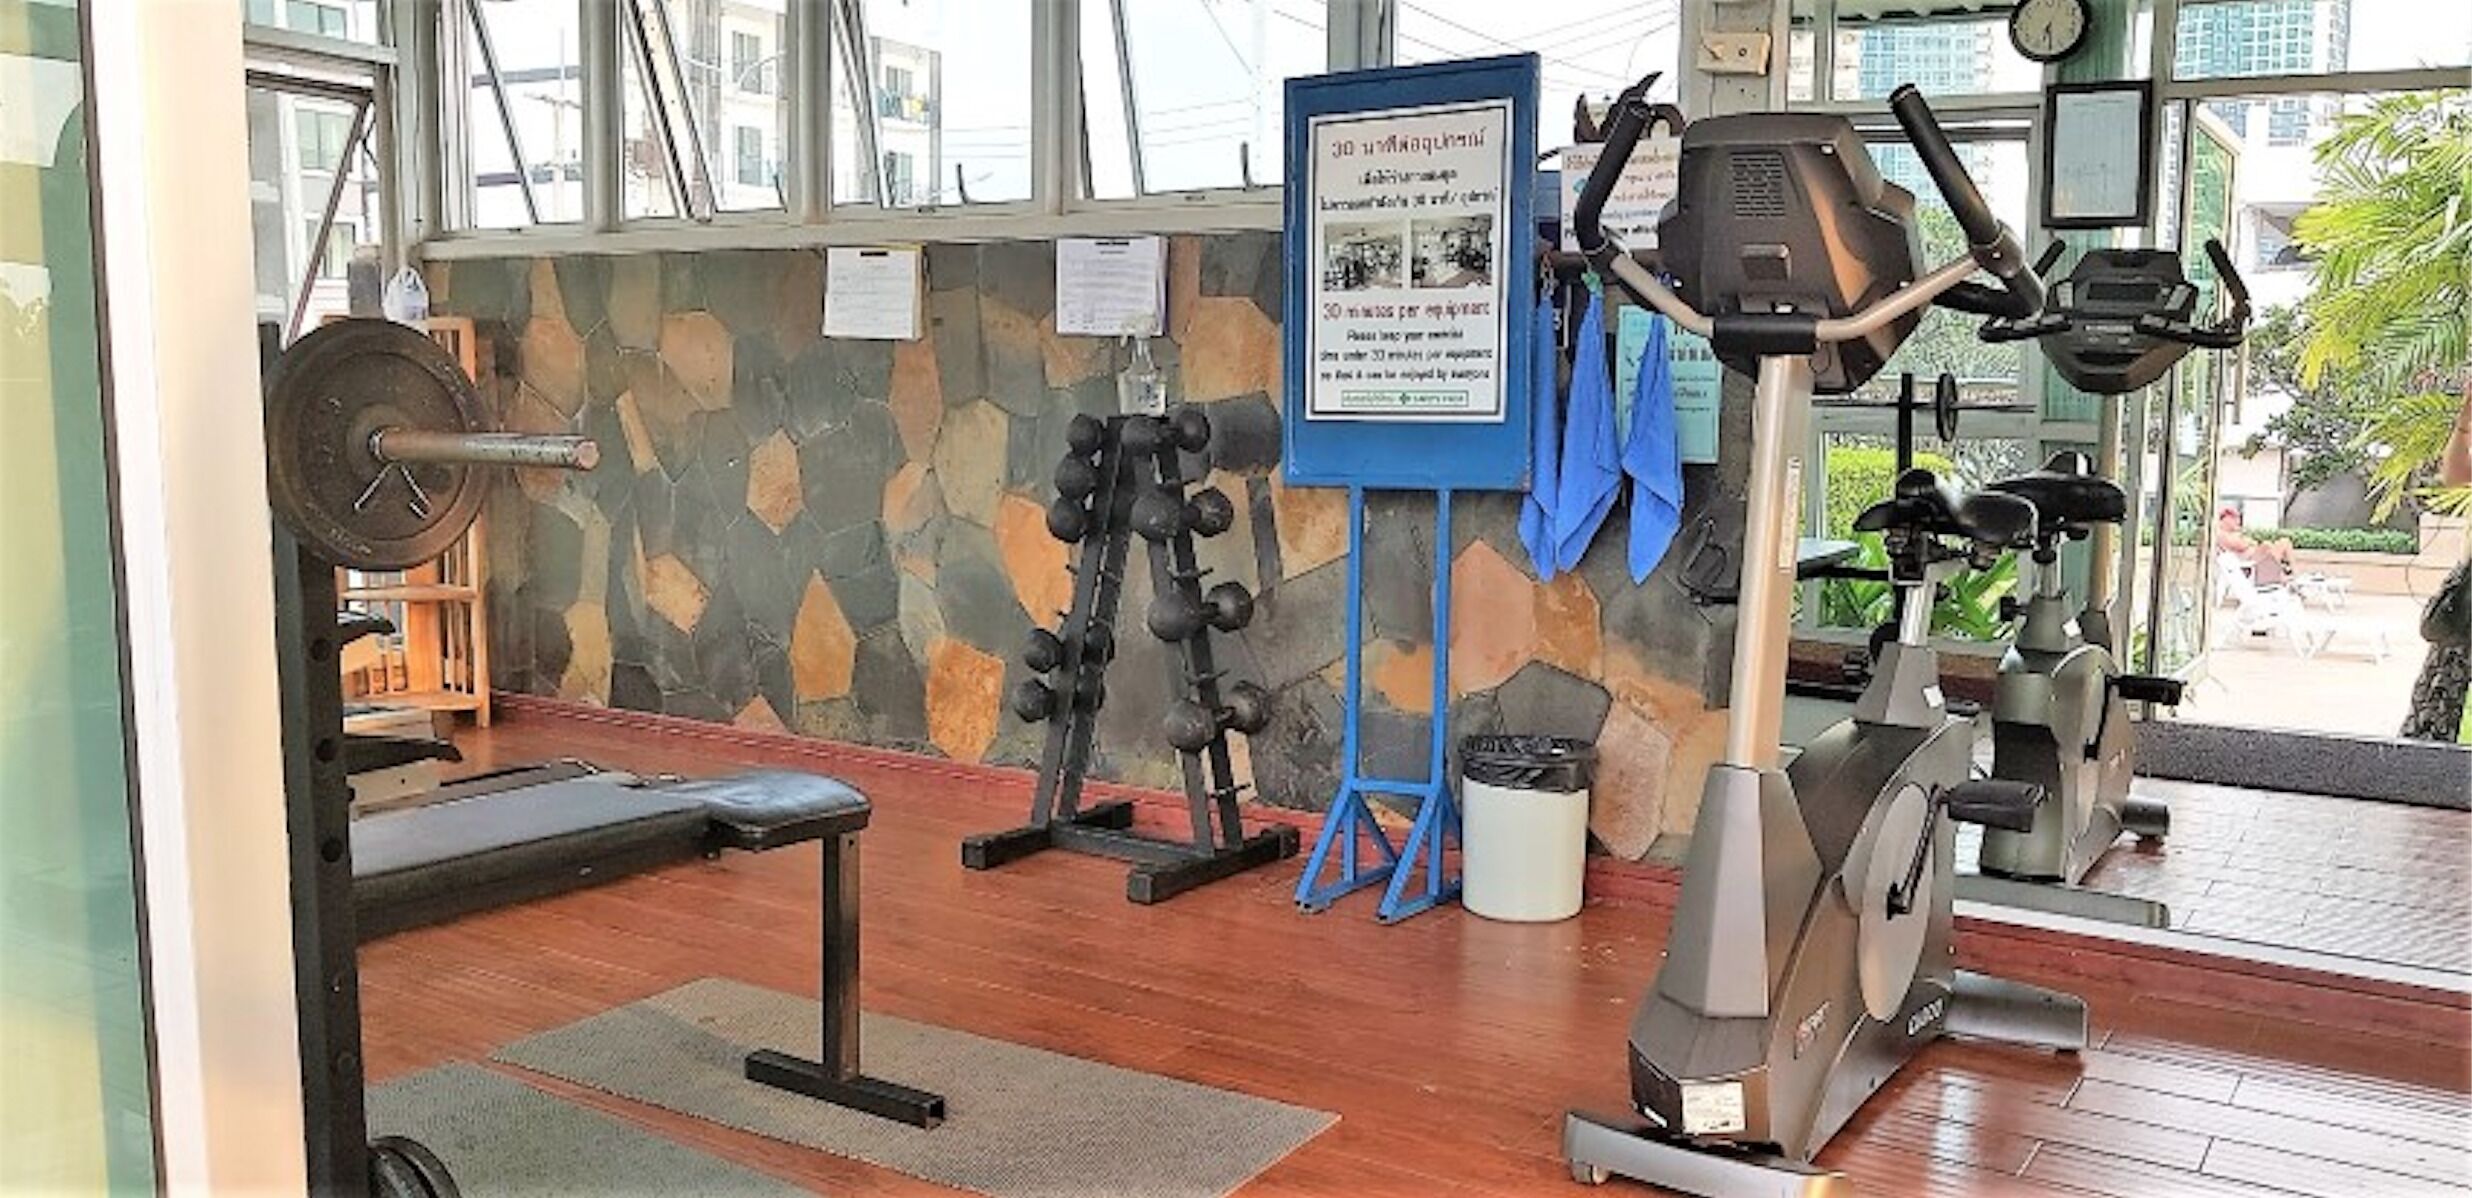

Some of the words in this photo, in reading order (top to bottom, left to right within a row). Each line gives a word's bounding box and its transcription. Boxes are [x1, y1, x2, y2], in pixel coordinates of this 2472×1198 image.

[1332, 139, 1354, 158] 30
[1323, 303, 1342, 321] 30
[1347, 304, 1393, 318] minutes
[1399, 305, 1420, 321] per
[1426, 300, 1490, 321] equipment
[1347, 329, 1376, 341] Please
[1404, 331, 1424, 343] your
[1343, 349, 1368, 361] under
